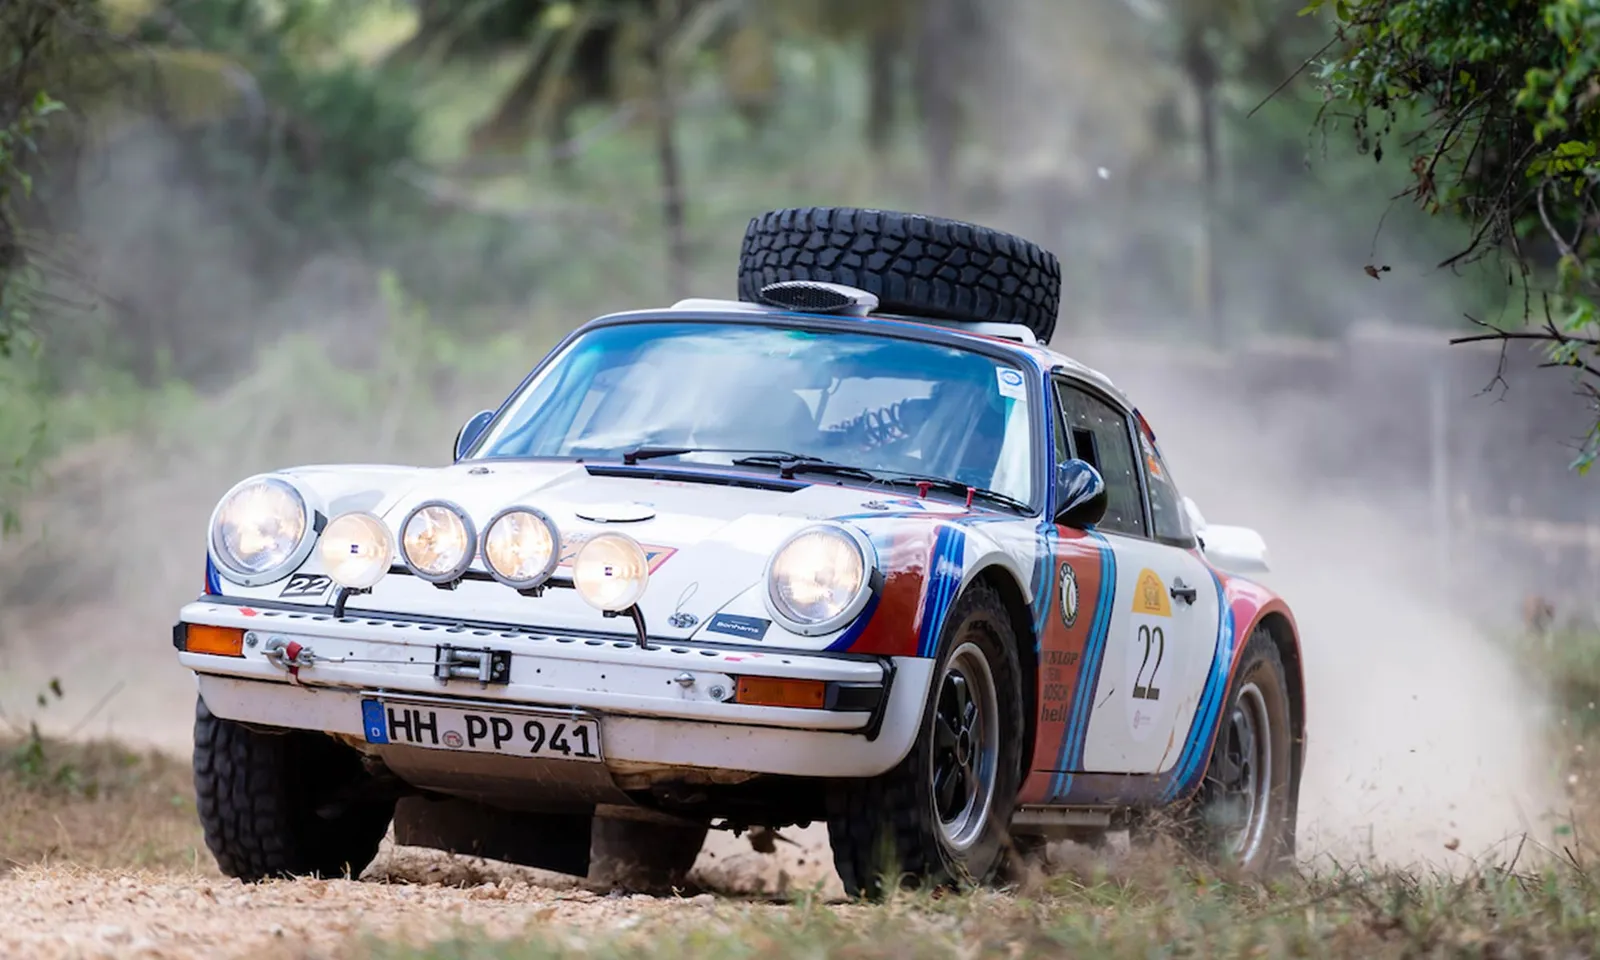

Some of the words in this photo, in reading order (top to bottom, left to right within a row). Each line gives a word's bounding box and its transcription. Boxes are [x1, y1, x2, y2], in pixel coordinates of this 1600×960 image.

[283, 577, 330, 594] 22
[716, 621, 760, 633] Bonhams
[1132, 624, 1165, 700] 22
[387, 708, 439, 744] HH
[464, 714, 513, 749] PP
[523, 720, 597, 758] 941
